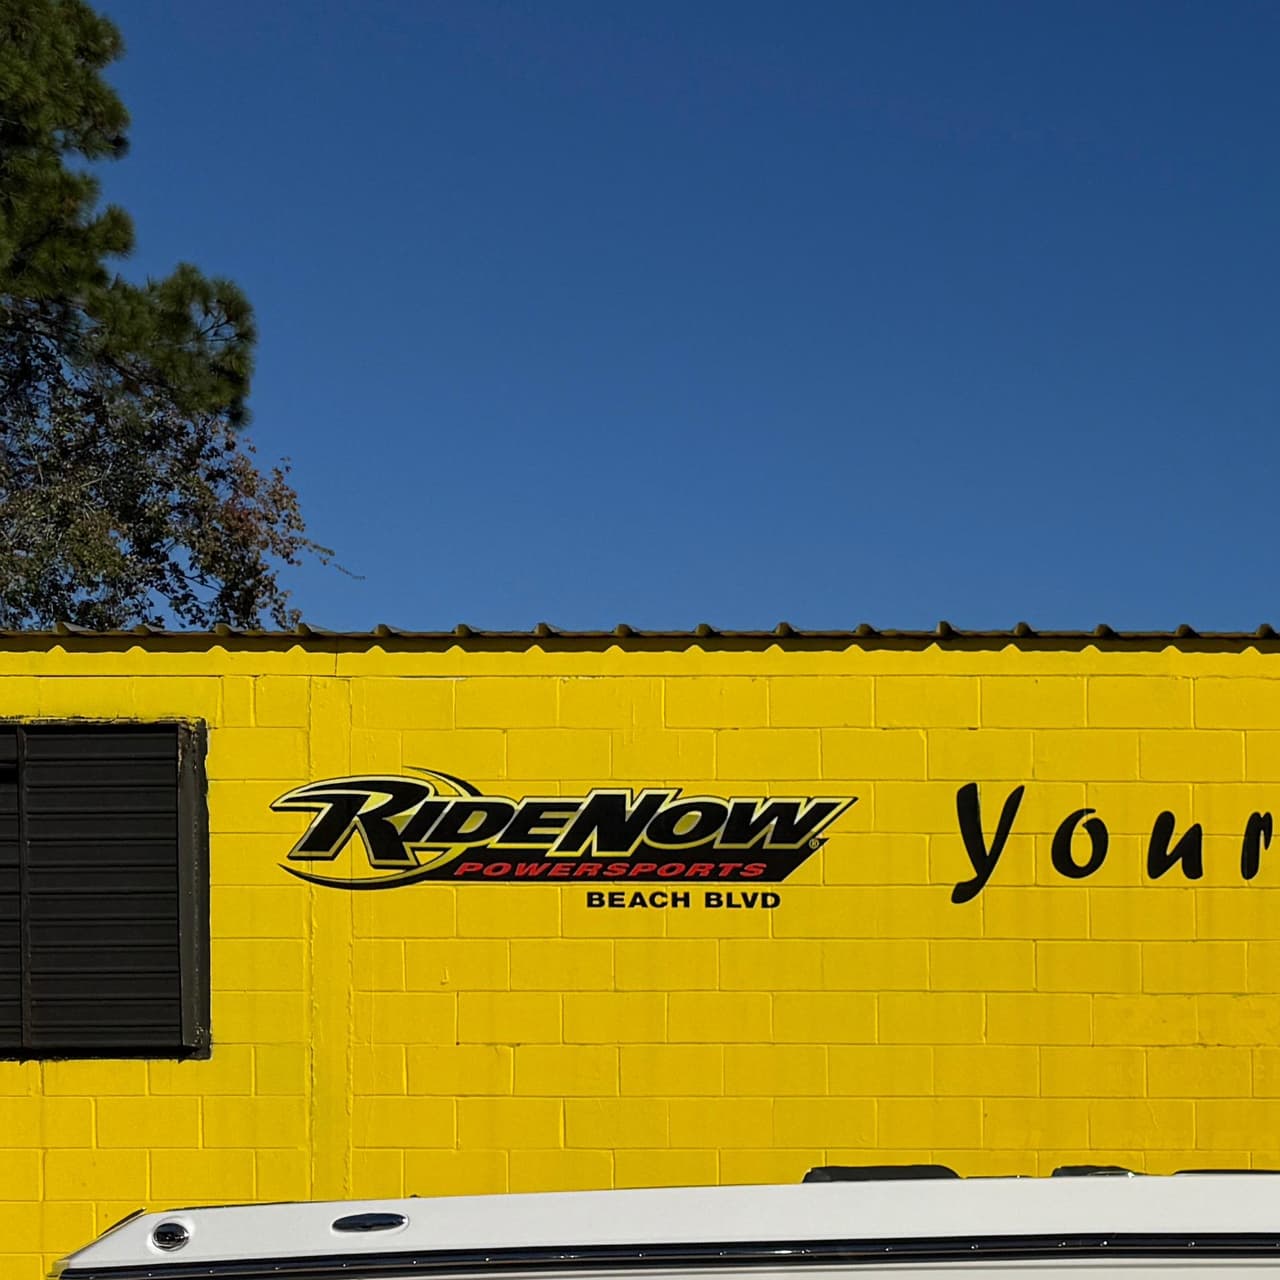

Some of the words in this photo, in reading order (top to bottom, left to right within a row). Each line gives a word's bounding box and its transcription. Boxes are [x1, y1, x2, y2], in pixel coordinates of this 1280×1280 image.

[453, 862, 767, 878] POWERSPORTS
[586, 891, 690, 908] BEACH
[704, 891, 781, 909] BLVD
